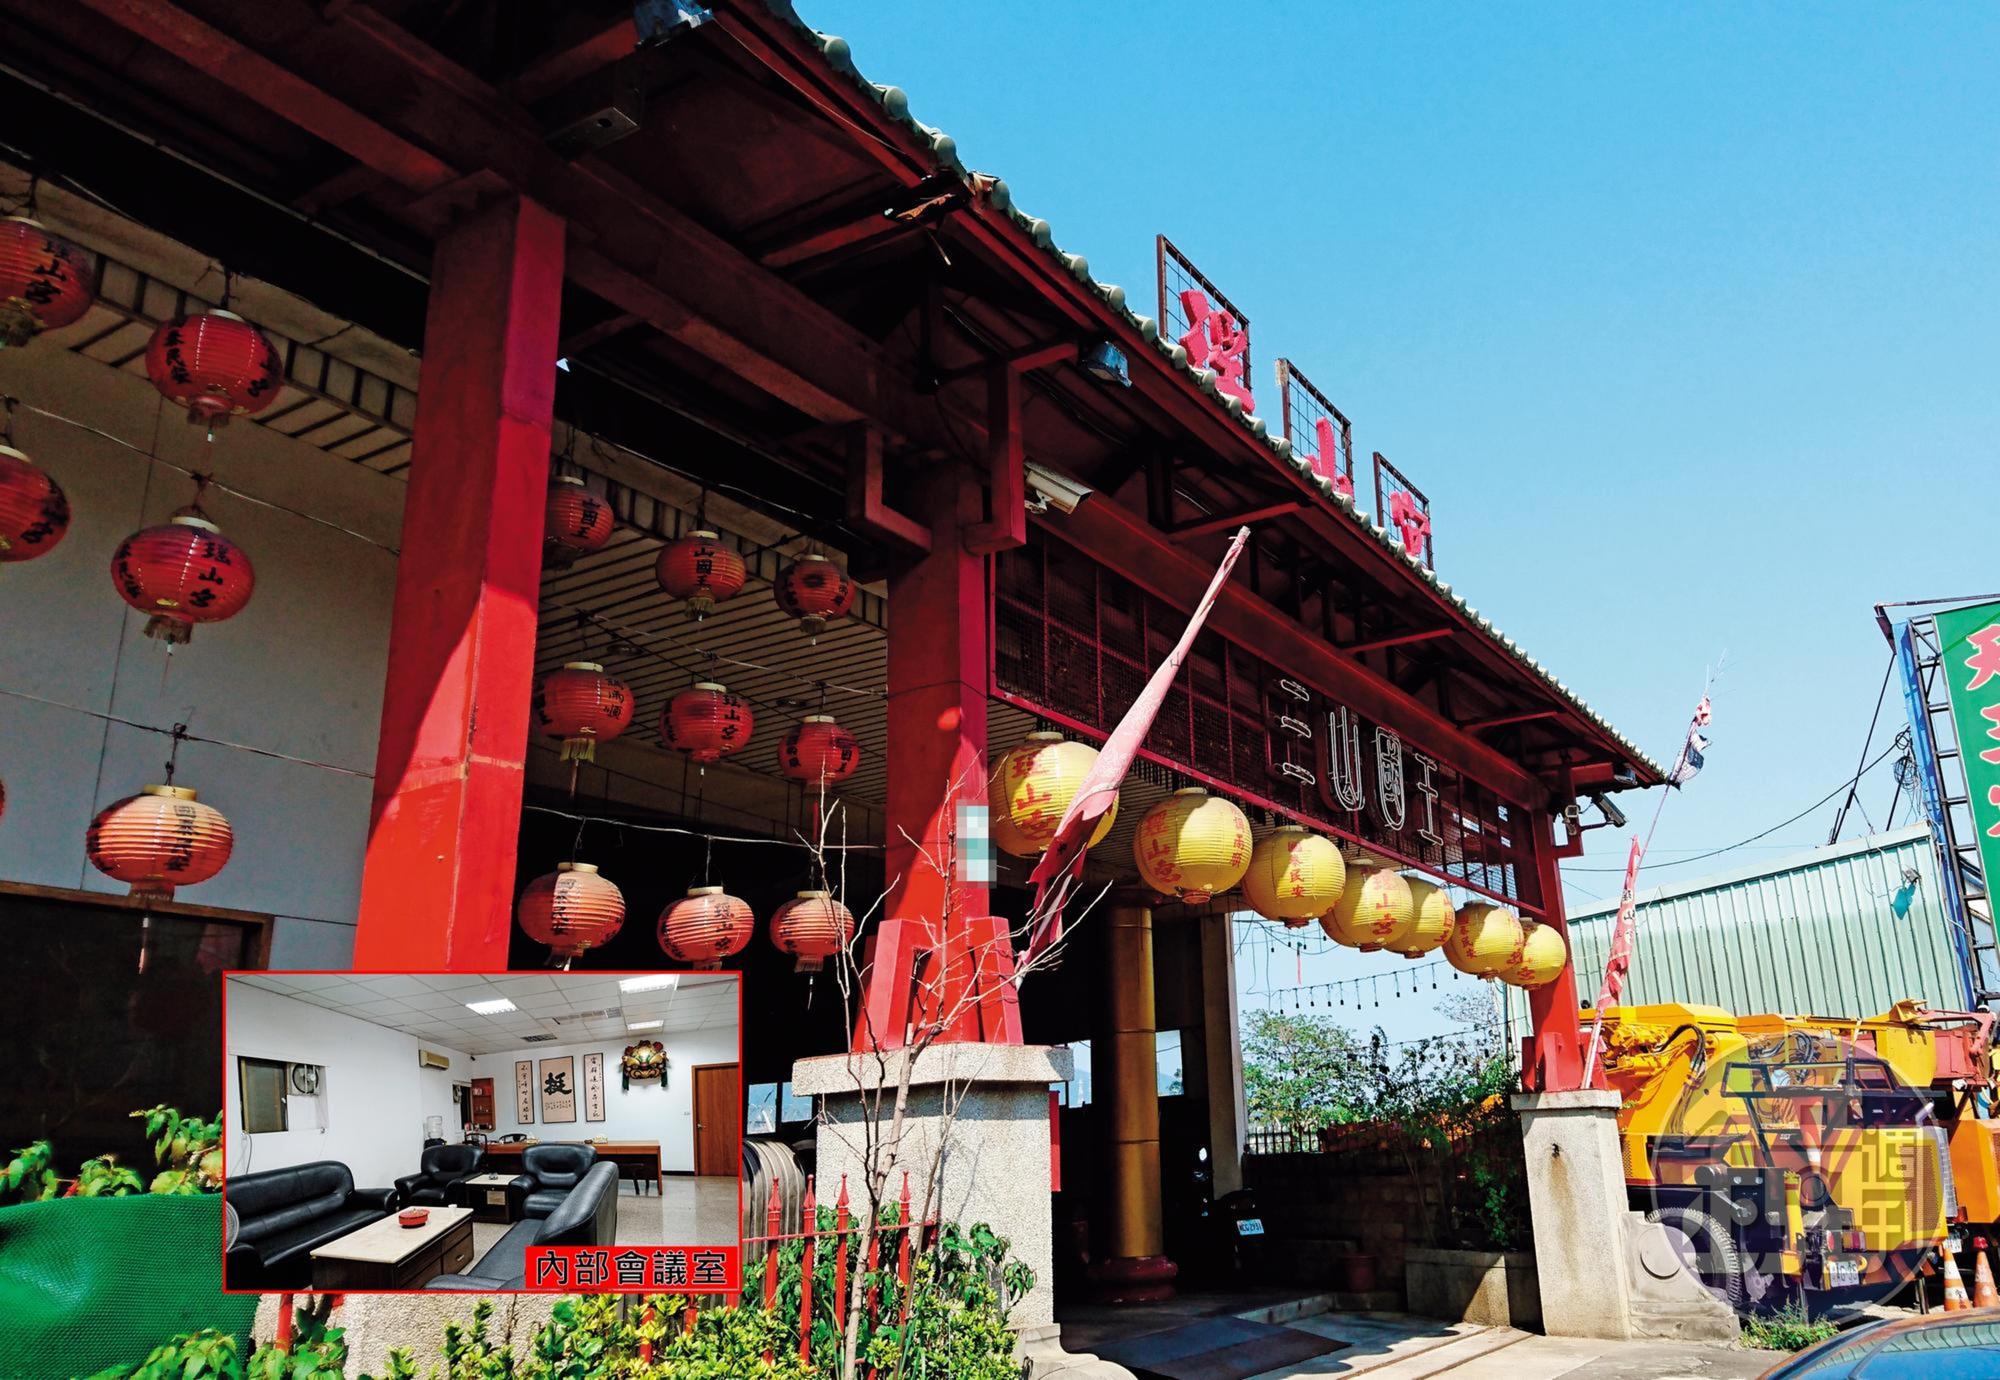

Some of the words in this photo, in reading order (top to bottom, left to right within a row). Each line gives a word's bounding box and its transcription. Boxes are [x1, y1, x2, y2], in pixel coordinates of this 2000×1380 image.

[1280, 679, 1444, 847] 三山國王
[1287, 839, 1306, 898] 國泰民安
[544, 1072, 572, 1095] 挺
